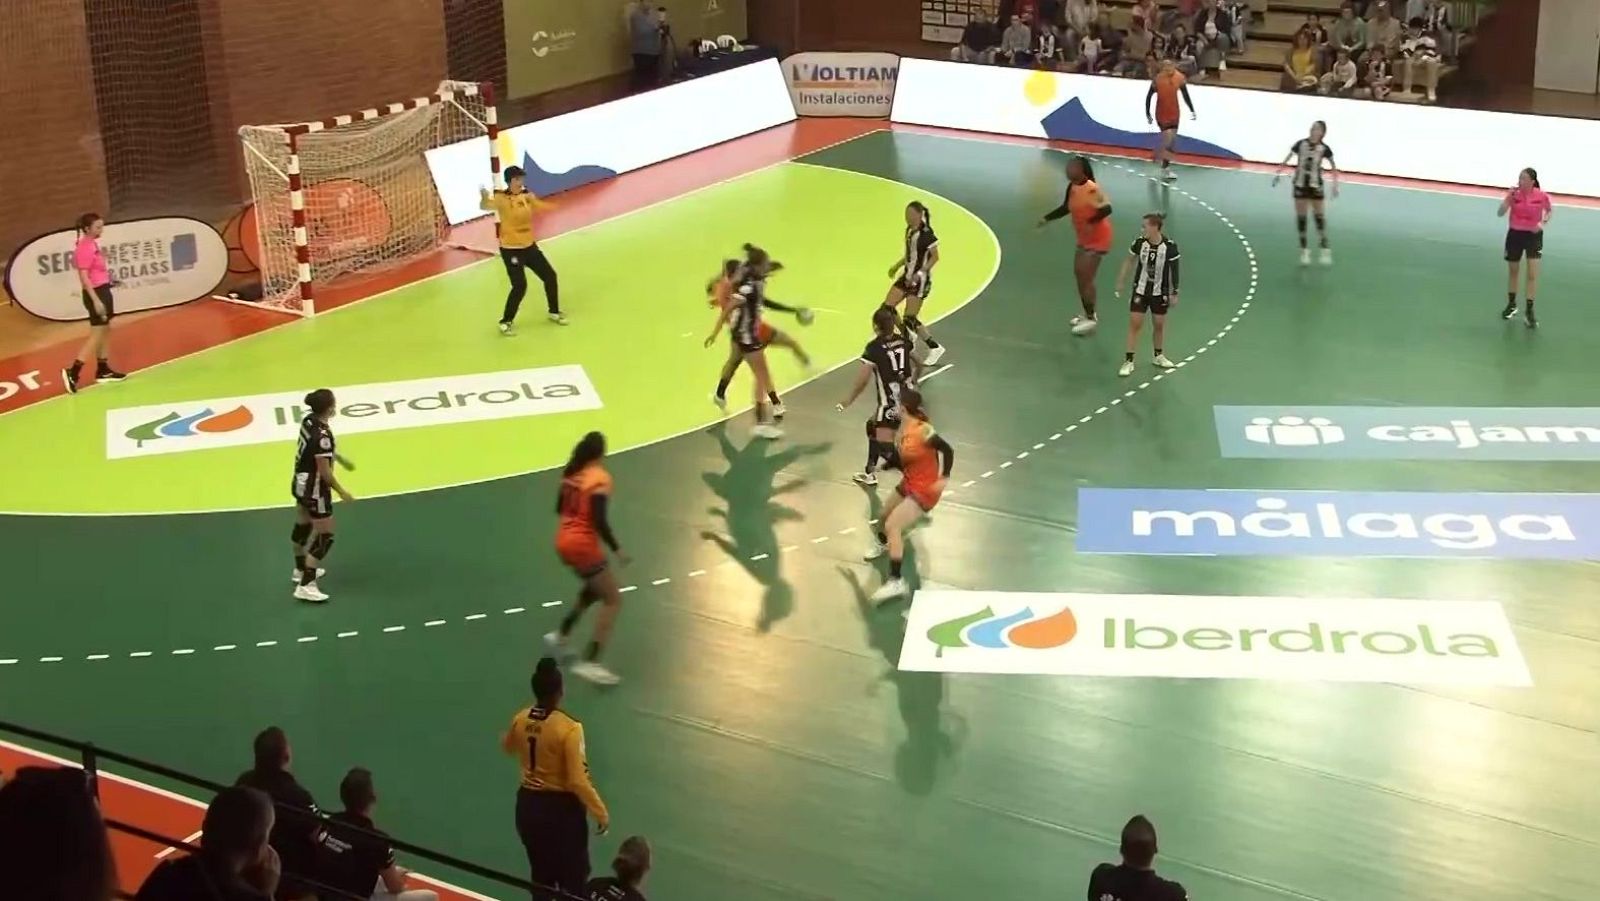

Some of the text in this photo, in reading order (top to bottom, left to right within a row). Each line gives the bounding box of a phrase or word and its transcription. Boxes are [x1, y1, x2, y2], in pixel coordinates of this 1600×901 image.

[799, 92, 891, 105] Instalaciones
[886, 347, 905, 371] 17
[1103, 617, 1499, 658] Iberdrola
[527, 735, 537, 771] 1
